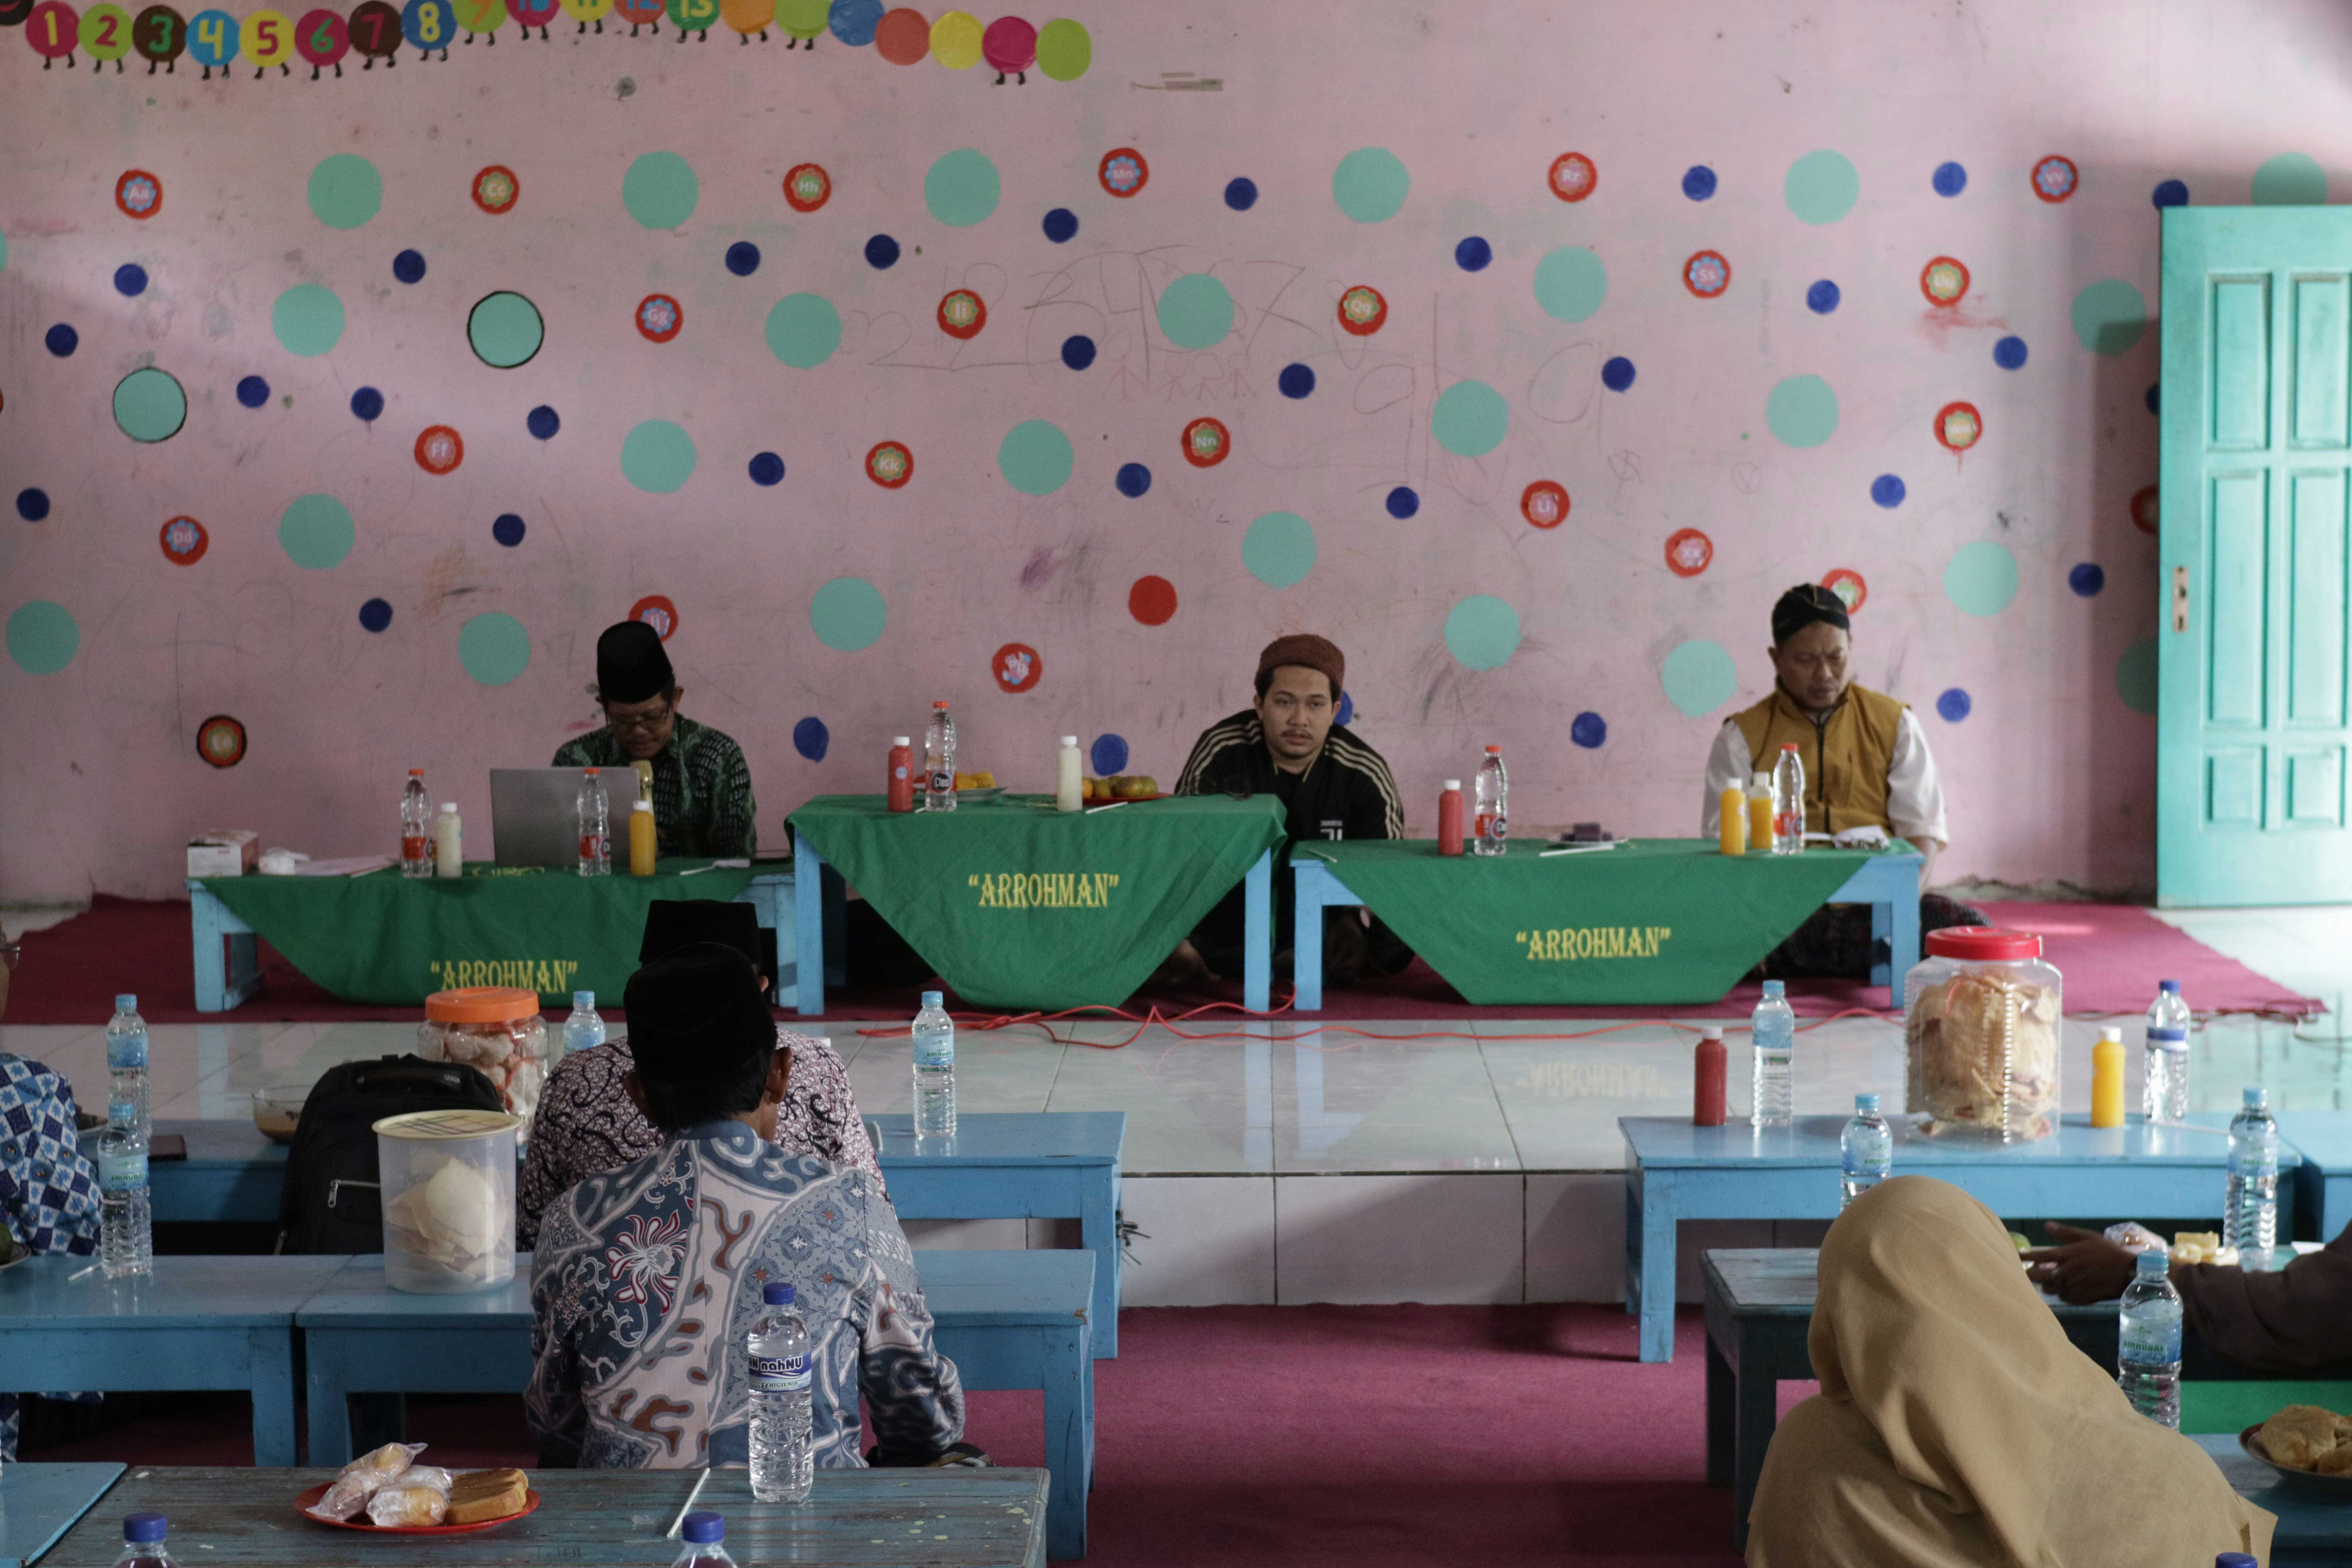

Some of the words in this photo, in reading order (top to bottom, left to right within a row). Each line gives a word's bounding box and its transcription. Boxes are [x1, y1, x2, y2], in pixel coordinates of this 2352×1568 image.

[44, 10, 58, 46] 1
[95, 15, 118, 47] 2
[149, 15, 174, 53] 3
[198, 19, 225, 60] 4
[257, 20, 278, 56] 5
[310, 18, 334, 53] 6
[361, 13, 385, 50] 7
[418, 2, 441, 43] 8
[1563, 169, 1580, 180] Rr
[129, 186, 149, 200] Aa
[488, 183, 506, 197] Cc
[800, 181, 818, 192] Hh
[1698, 269, 1715, 279] Ss
[1351, 299, 1371, 316] Qq
[649, 308, 668, 326] Gg
[1196, 437, 1217, 447] Nn
[432, 442, 449, 458] Ff
[880, 459, 898, 470] Kk
[935, 777, 949, 788] Cleo
[760, 1355, 803, 1372] nahNU
